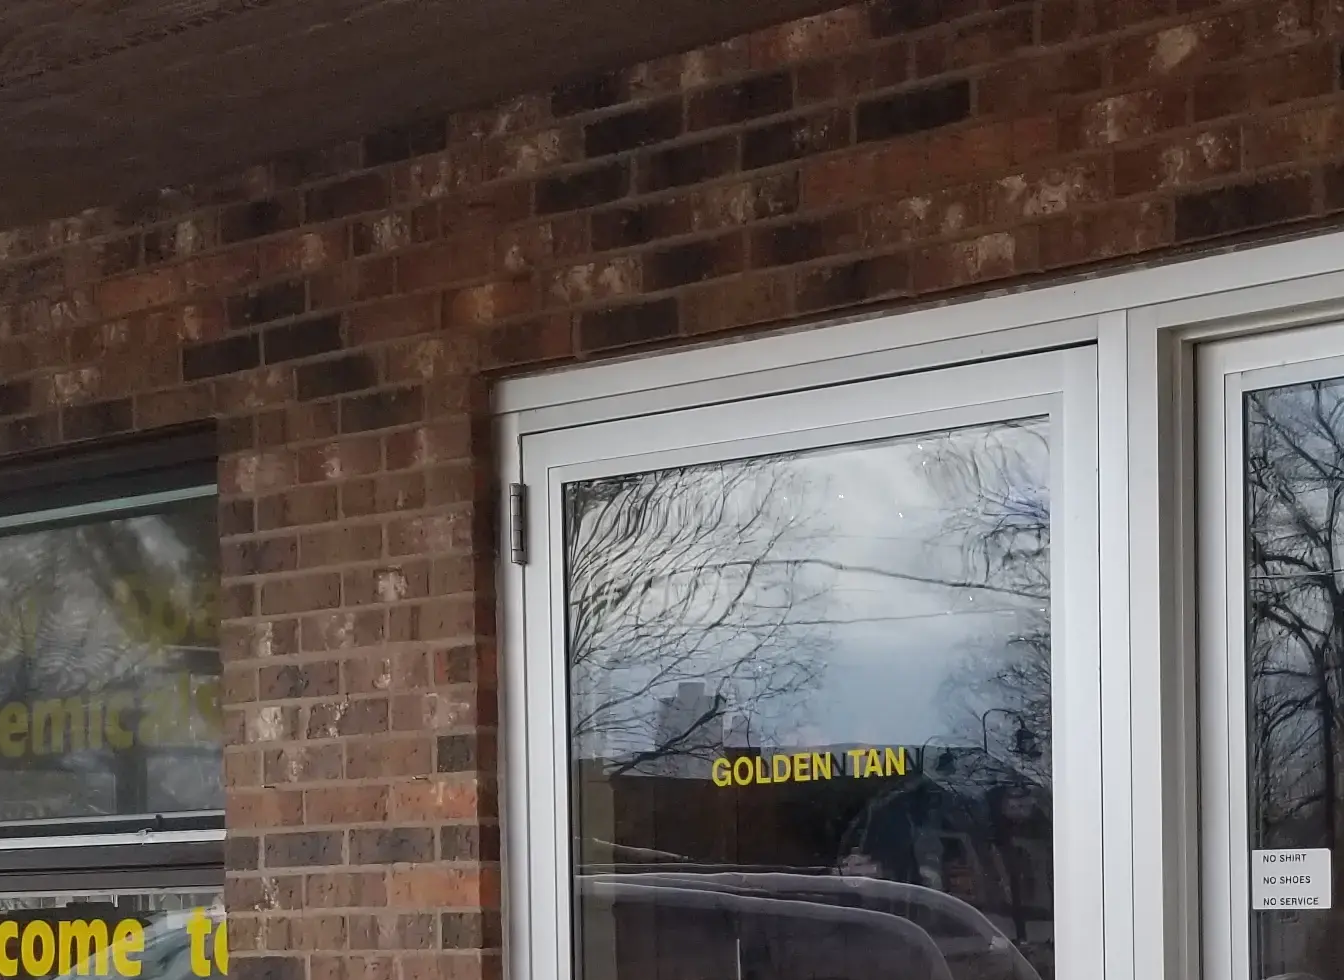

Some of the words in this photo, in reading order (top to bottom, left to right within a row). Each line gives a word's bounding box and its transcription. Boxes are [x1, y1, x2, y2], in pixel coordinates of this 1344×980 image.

[712, 752, 832, 787] GOLDEN
[847, 746, 906, 779] TAN
[1263, 855, 1276, 863] NO
[1279, 854, 1307, 862] SHIRT
[1263, 877, 1276, 885] NO
[1279, 876, 1311, 884] SHOES
[1264, 898, 1276, 906] NO
[1280, 897, 1319, 905] SERVICE
